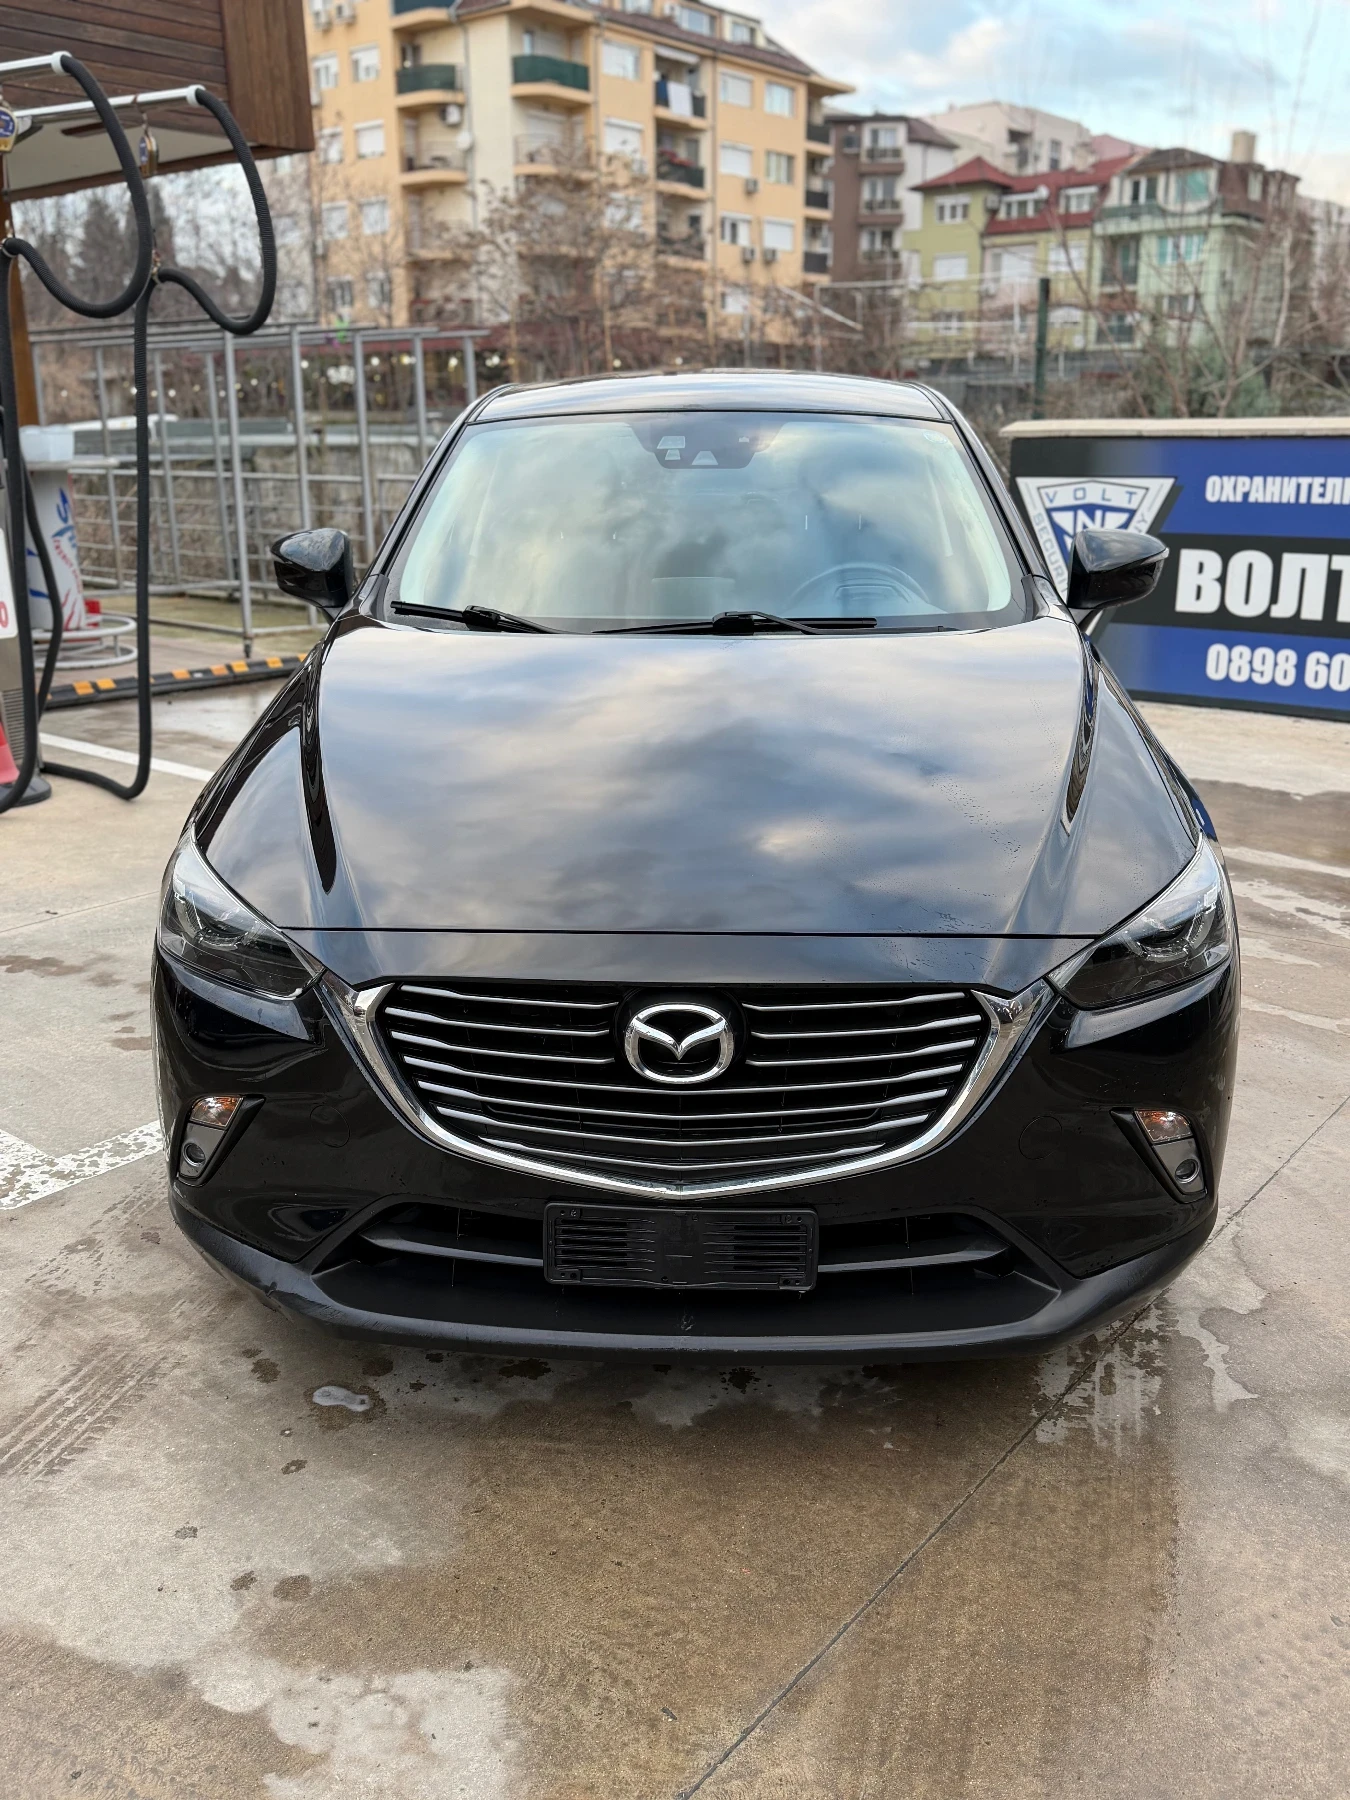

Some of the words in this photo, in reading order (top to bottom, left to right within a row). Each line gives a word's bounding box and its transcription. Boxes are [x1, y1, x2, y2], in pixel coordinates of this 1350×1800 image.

[1044, 487, 1138, 505] VOLT
[1206, 643, 1298, 687] 0898
[1304, 651, 1350, 692] 60
